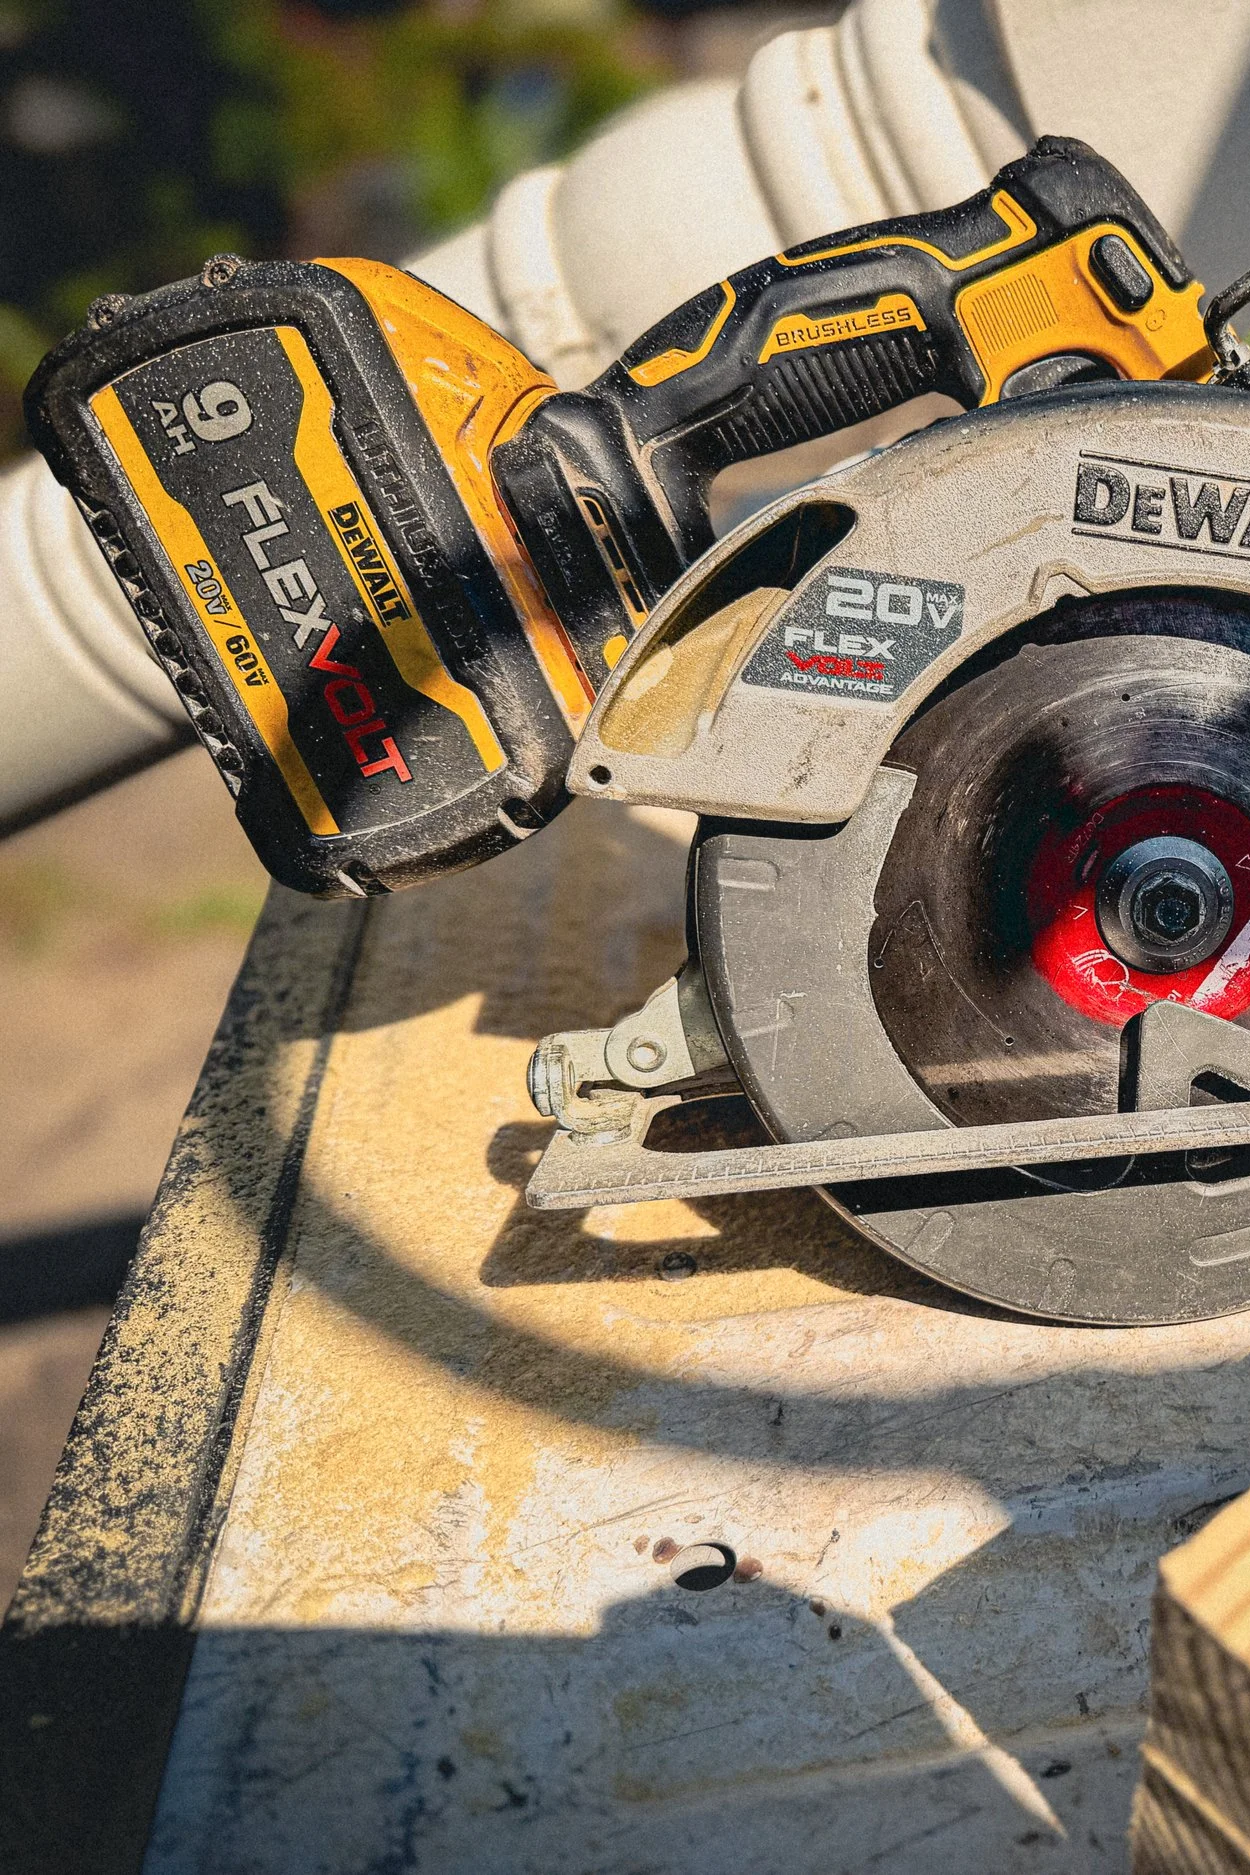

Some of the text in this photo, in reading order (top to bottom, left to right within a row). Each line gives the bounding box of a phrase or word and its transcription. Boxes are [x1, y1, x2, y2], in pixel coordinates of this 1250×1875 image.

[776, 307, 912, 347] BRUSHLESS
[151, 400, 197, 456] AH
[182, 380, 252, 442] 9
[221, 480, 412, 783] FLEXVOLT
[784, 626, 897, 660] FLEX
[779, 672, 895, 695] ADVANTAGE
[785, 650, 886, 681] VOLT
